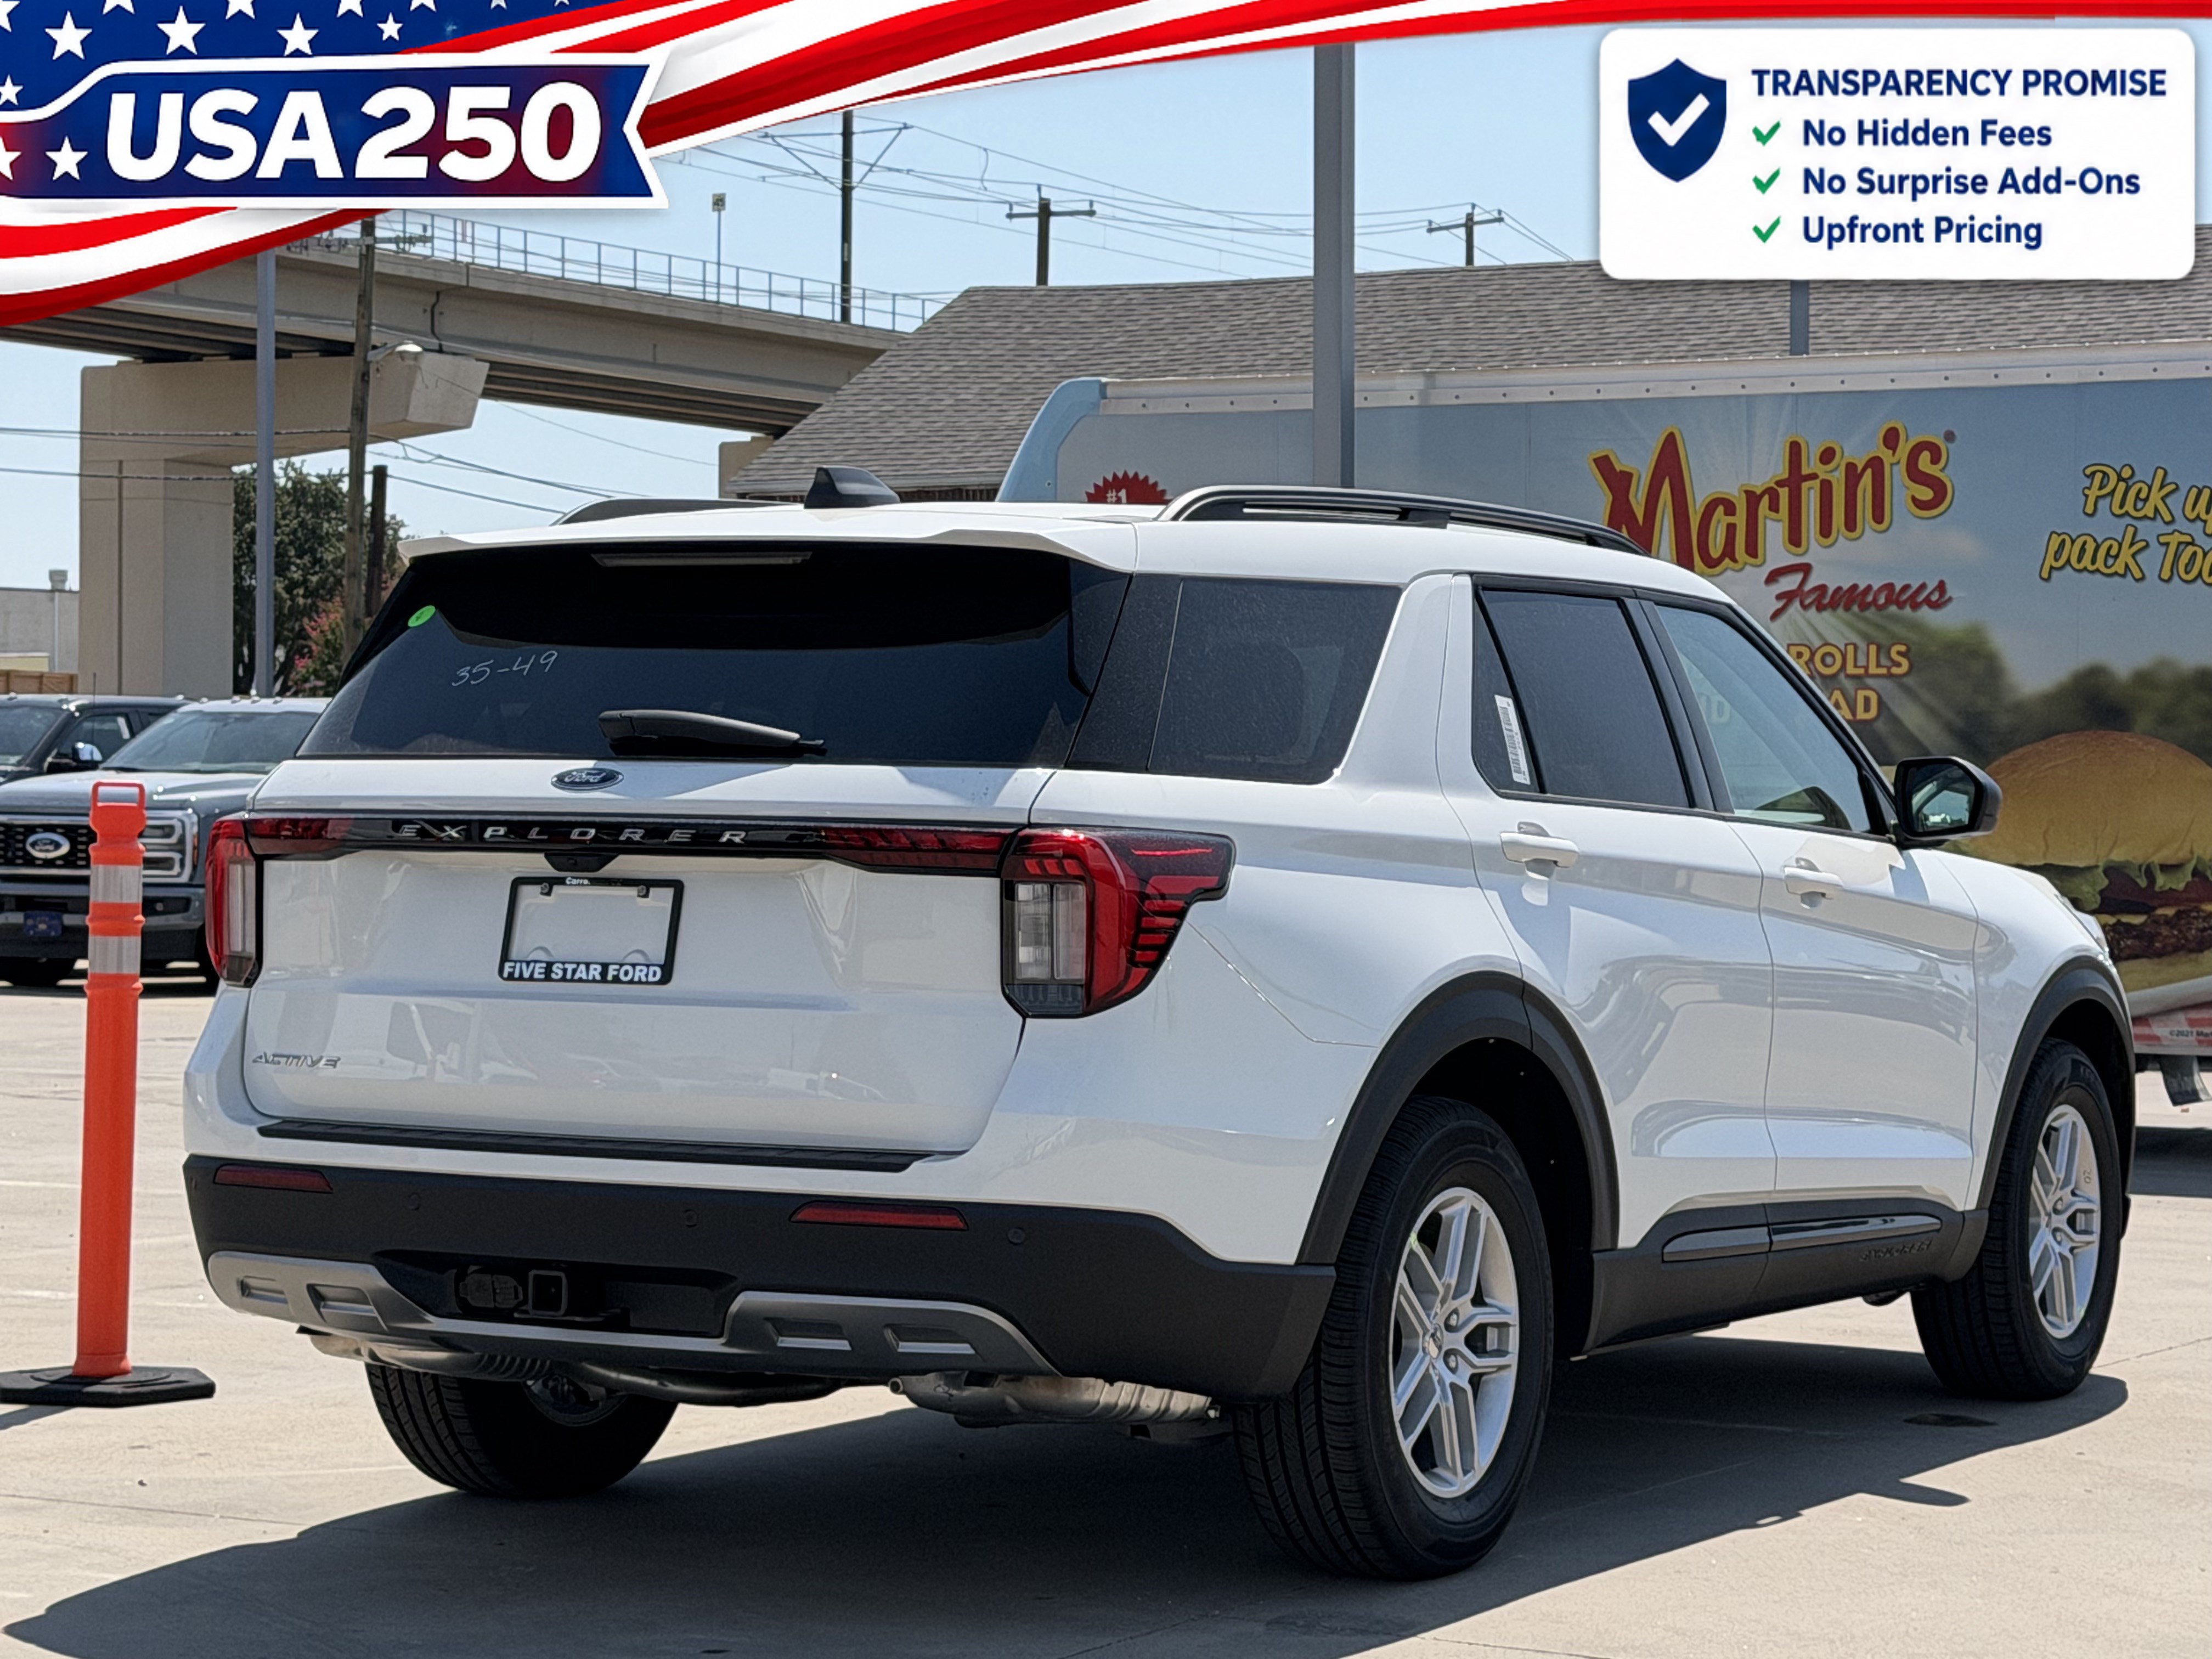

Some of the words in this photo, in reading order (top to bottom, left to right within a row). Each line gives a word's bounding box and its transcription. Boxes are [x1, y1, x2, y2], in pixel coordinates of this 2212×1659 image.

[1588, 420, 1954, 575] Martin's
[2083, 464, 2179, 523] Pick
[2039, 524, 2148, 583] pack
[1764, 562, 1954, 622] Famous
[452, 650, 558, 687] 35-49
[1787, 642, 1911, 678] ROLLS
[564, 769, 606, 783] Ford
[398, 824, 747, 844] EXPLORER
[502, 962, 546, 979] FIVE
[550, 963, 602, 980] STAR
[606, 964, 662, 982] FORD
